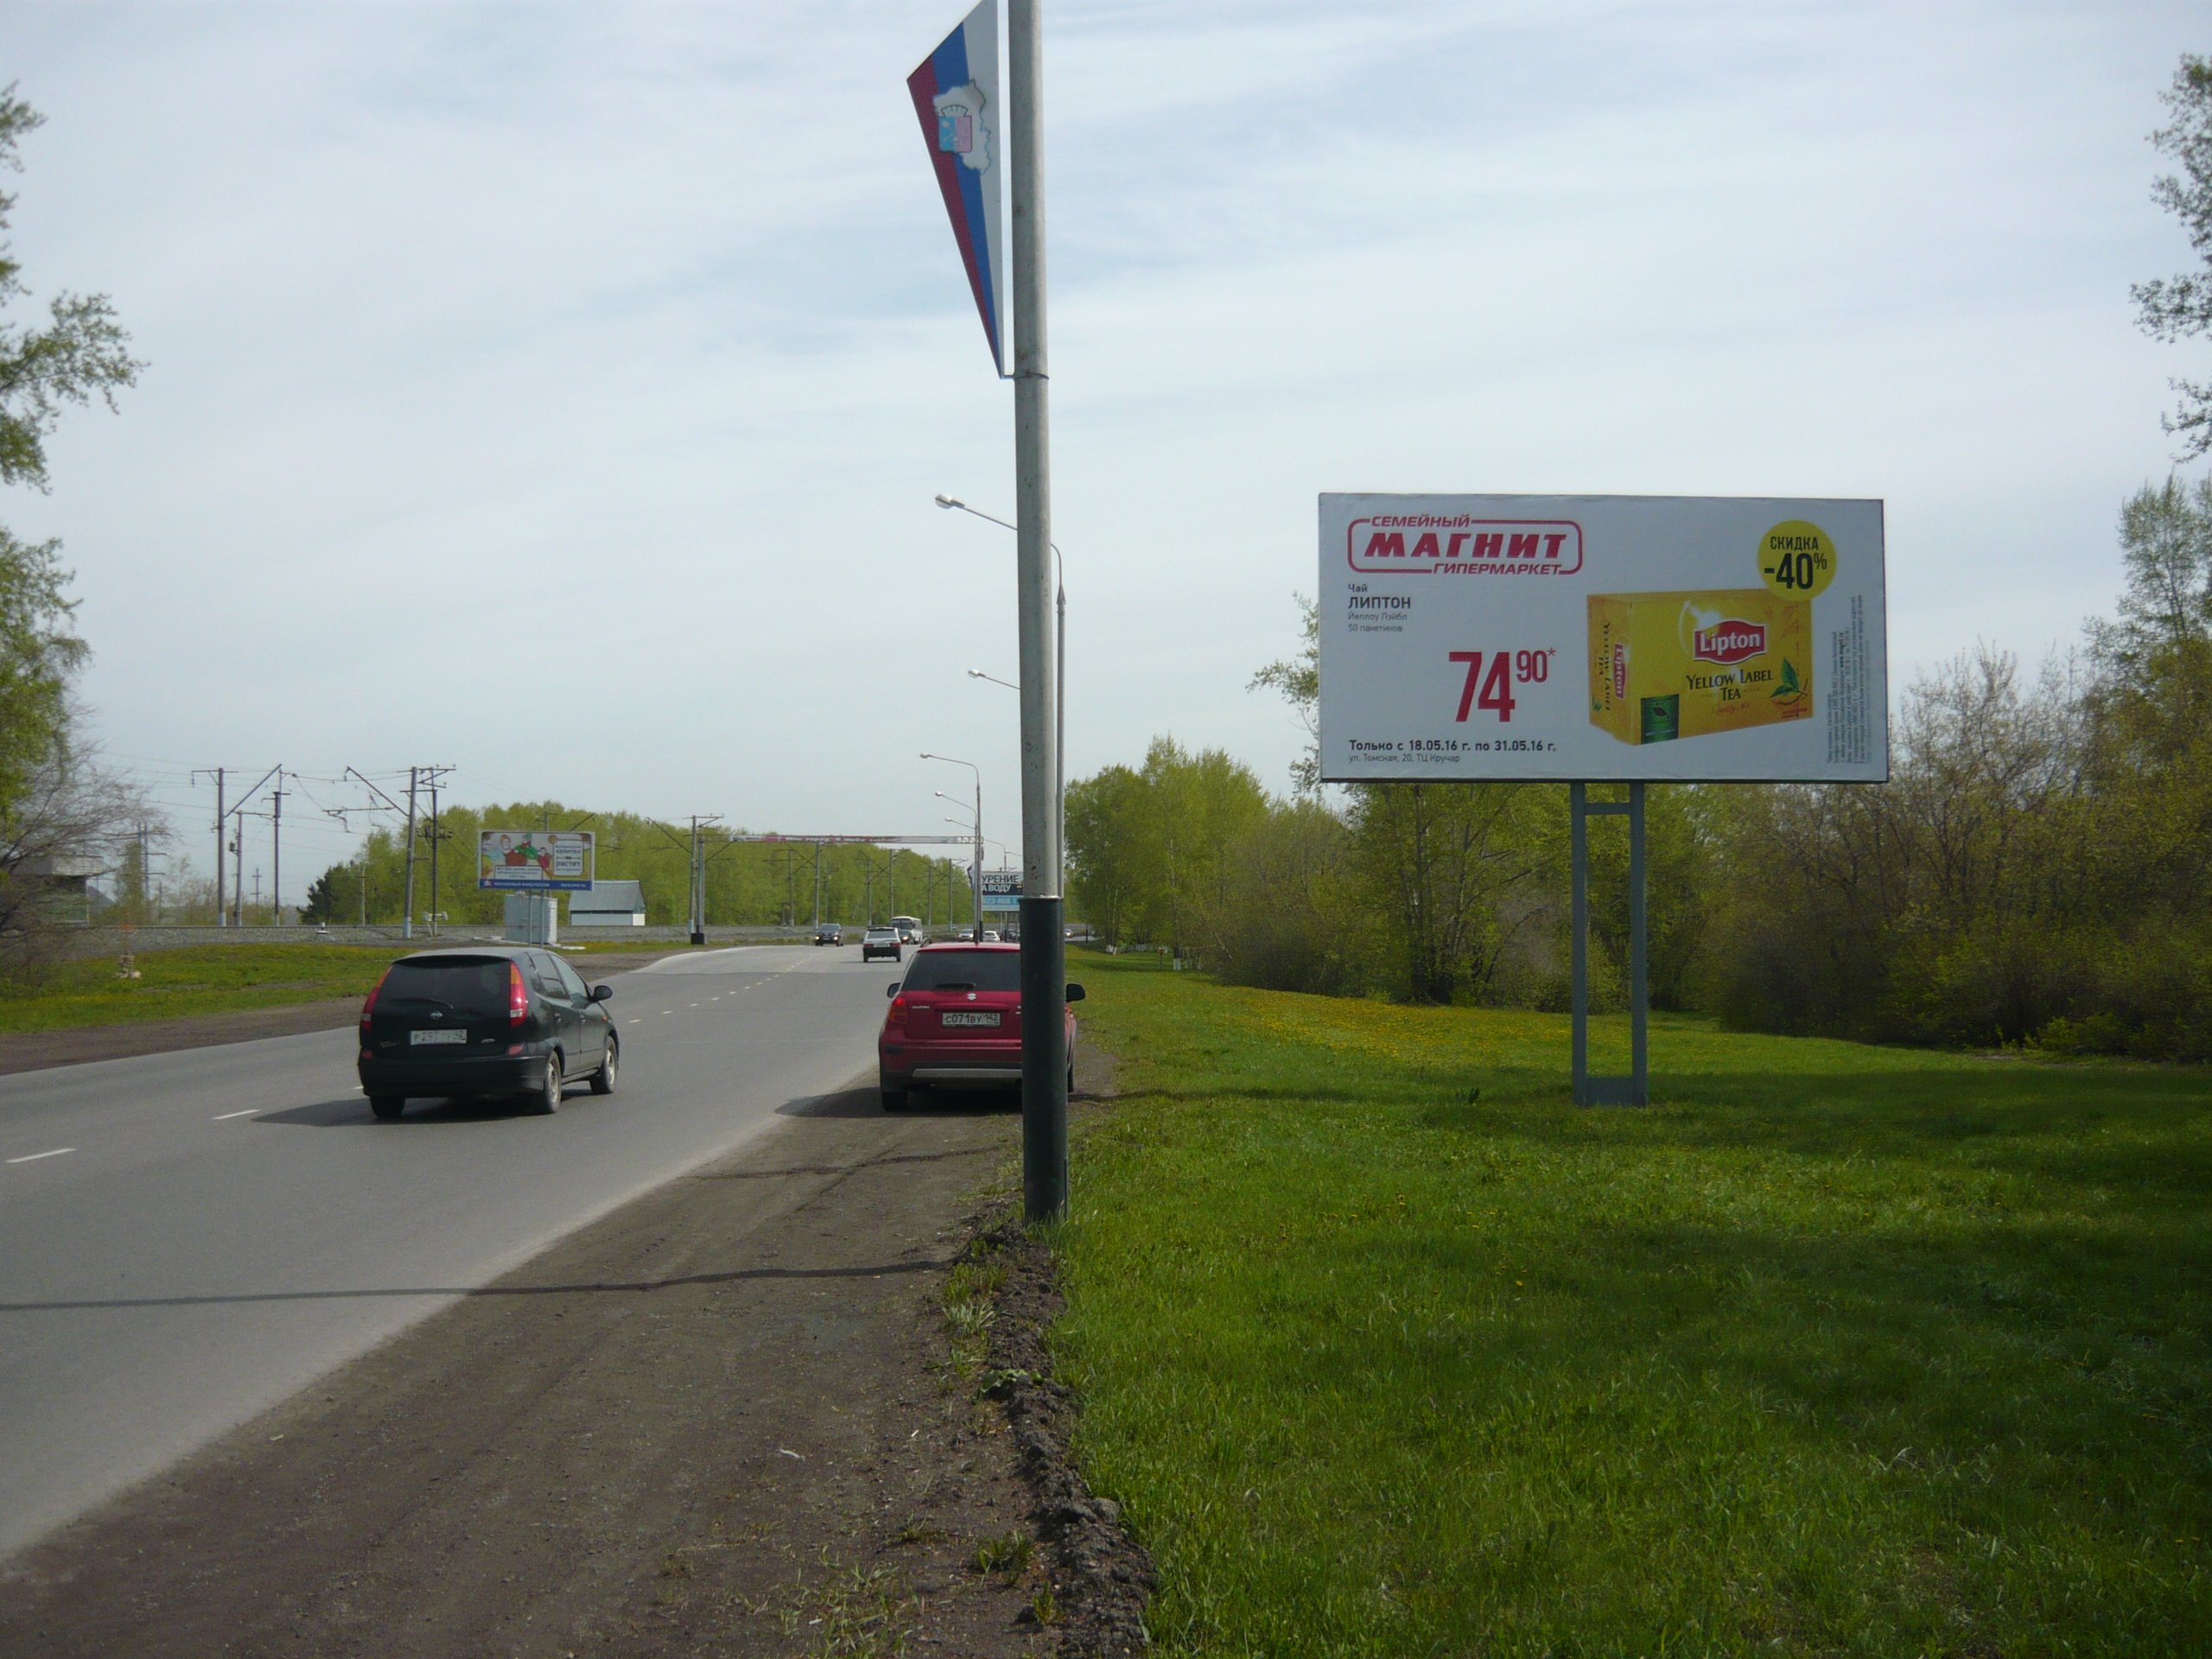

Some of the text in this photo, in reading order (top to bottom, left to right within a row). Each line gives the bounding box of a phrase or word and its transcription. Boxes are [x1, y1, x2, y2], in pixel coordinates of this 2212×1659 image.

[1370, 514, 1471, 529] СЕМЕЙНЫЙ
[1363, 532, 1567, 559] МАГНИТ
[1770, 536, 1819, 551] СКИДКА
[1432, 563, 1562, 576] ГИПЕРМАРКЕТ
[1764, 552, 1827, 590] -40%
[1347, 583, 1368, 594] Чай
[1348, 596, 1412, 610] ЛИПТОН
[1347, 611, 1408, 622] Йеллоу Лэйбл
[1347, 623, 1403, 633] 50 пакетиков
[1699, 631, 1761, 657] Lipton
[1614, 647, 1623, 695] Lipton
[1686, 668, 1774, 690] YELLOW LABEL
[1720, 687, 1741, 702] TEA
[1349, 740, 1557, 753] Только с 18.05.16 г. по 31.05.16 г.
[1416, 753, 1428, 764] ТЦ
[982, 874, 1020, 883] УРЕНИЕ
[988, 884, 1012, 893] ВОДУ
